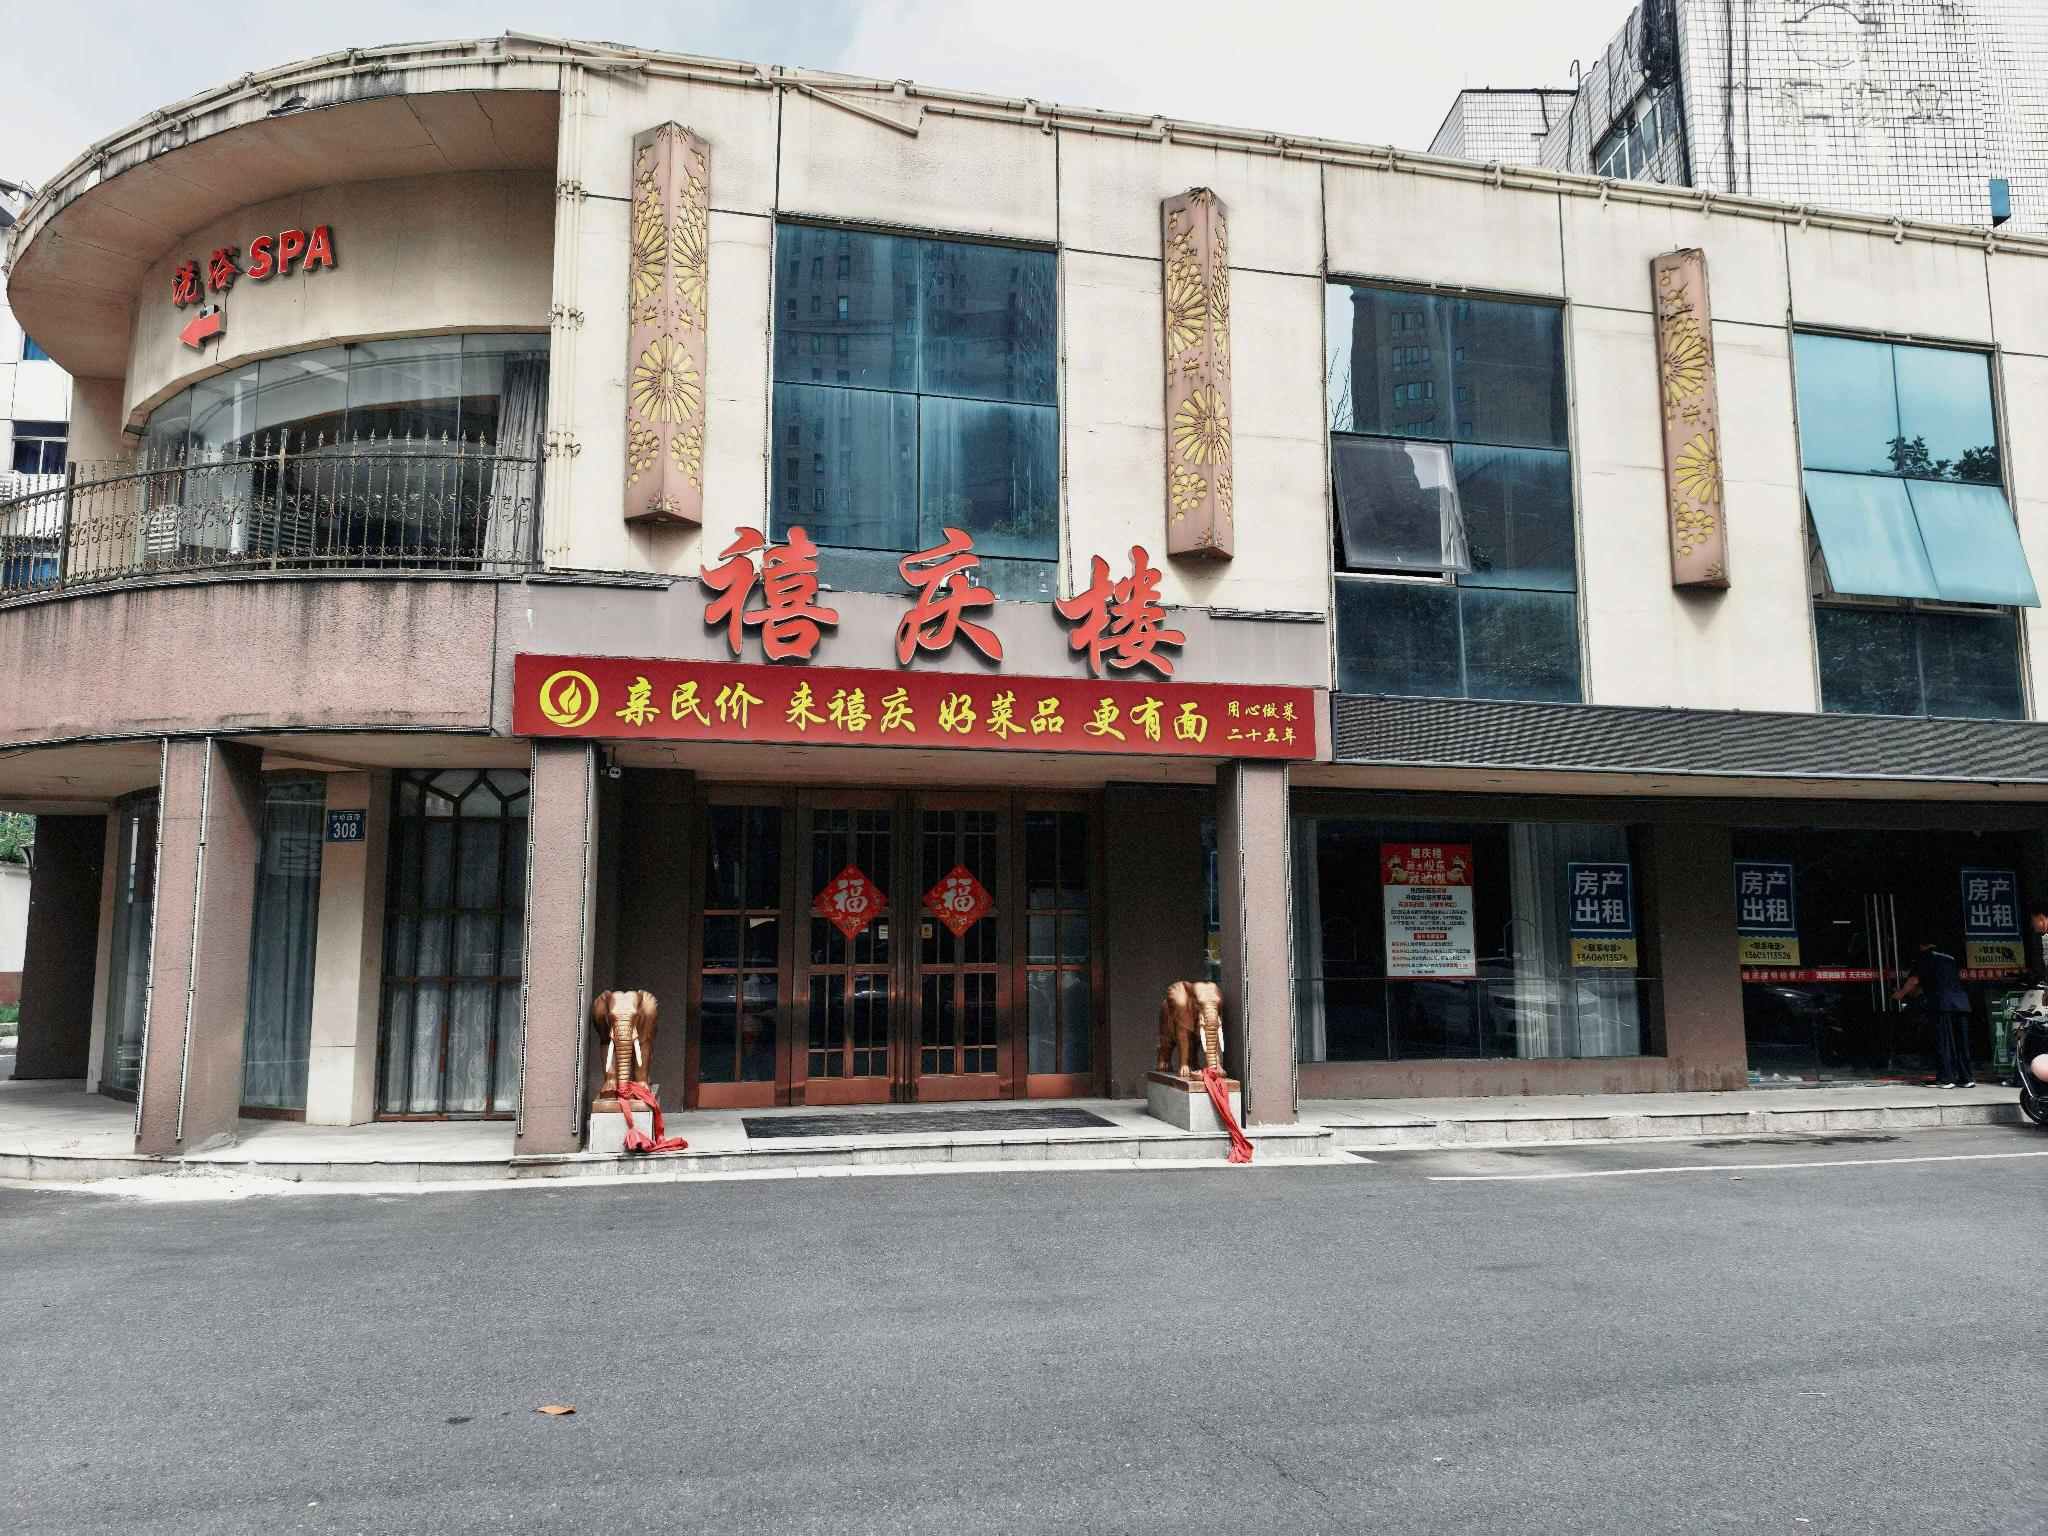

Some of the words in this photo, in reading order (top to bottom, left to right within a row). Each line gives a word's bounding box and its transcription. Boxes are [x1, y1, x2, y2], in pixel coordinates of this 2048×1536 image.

[172, 245, 236, 305] 洗浴
[247, 224, 333, 279] SPA
[701, 526, 1187, 676] 禧庆楼
[615, 676, 764, 729] 亲民价
[786, 681, 916, 733] 来禧庆
[938, 691, 1065, 740] 好菜品
[1084, 697, 1208, 743] 更有面
[1227, 700, 1298, 721] 用心做菜
[1227, 727, 1297, 746] 二十五年
[333, 823, 357, 838] 308
[1411, 847, 1442, 859] 禧庆楼
[833, 878, 868, 913] 福
[941, 878, 975, 912] 福
[1574, 870, 1623, 896] 房产
[1741, 870, 1787, 896] 房产
[1968, 877, 2010, 901] 房产
[1575, 898, 1626, 924] 出租
[1743, 897, 1790, 923] 出租
[1970, 903, 2014, 928] 出租
[1576, 953, 1629, 962] 13606113526
[1744, 951, 1791, 961] 13606113526
